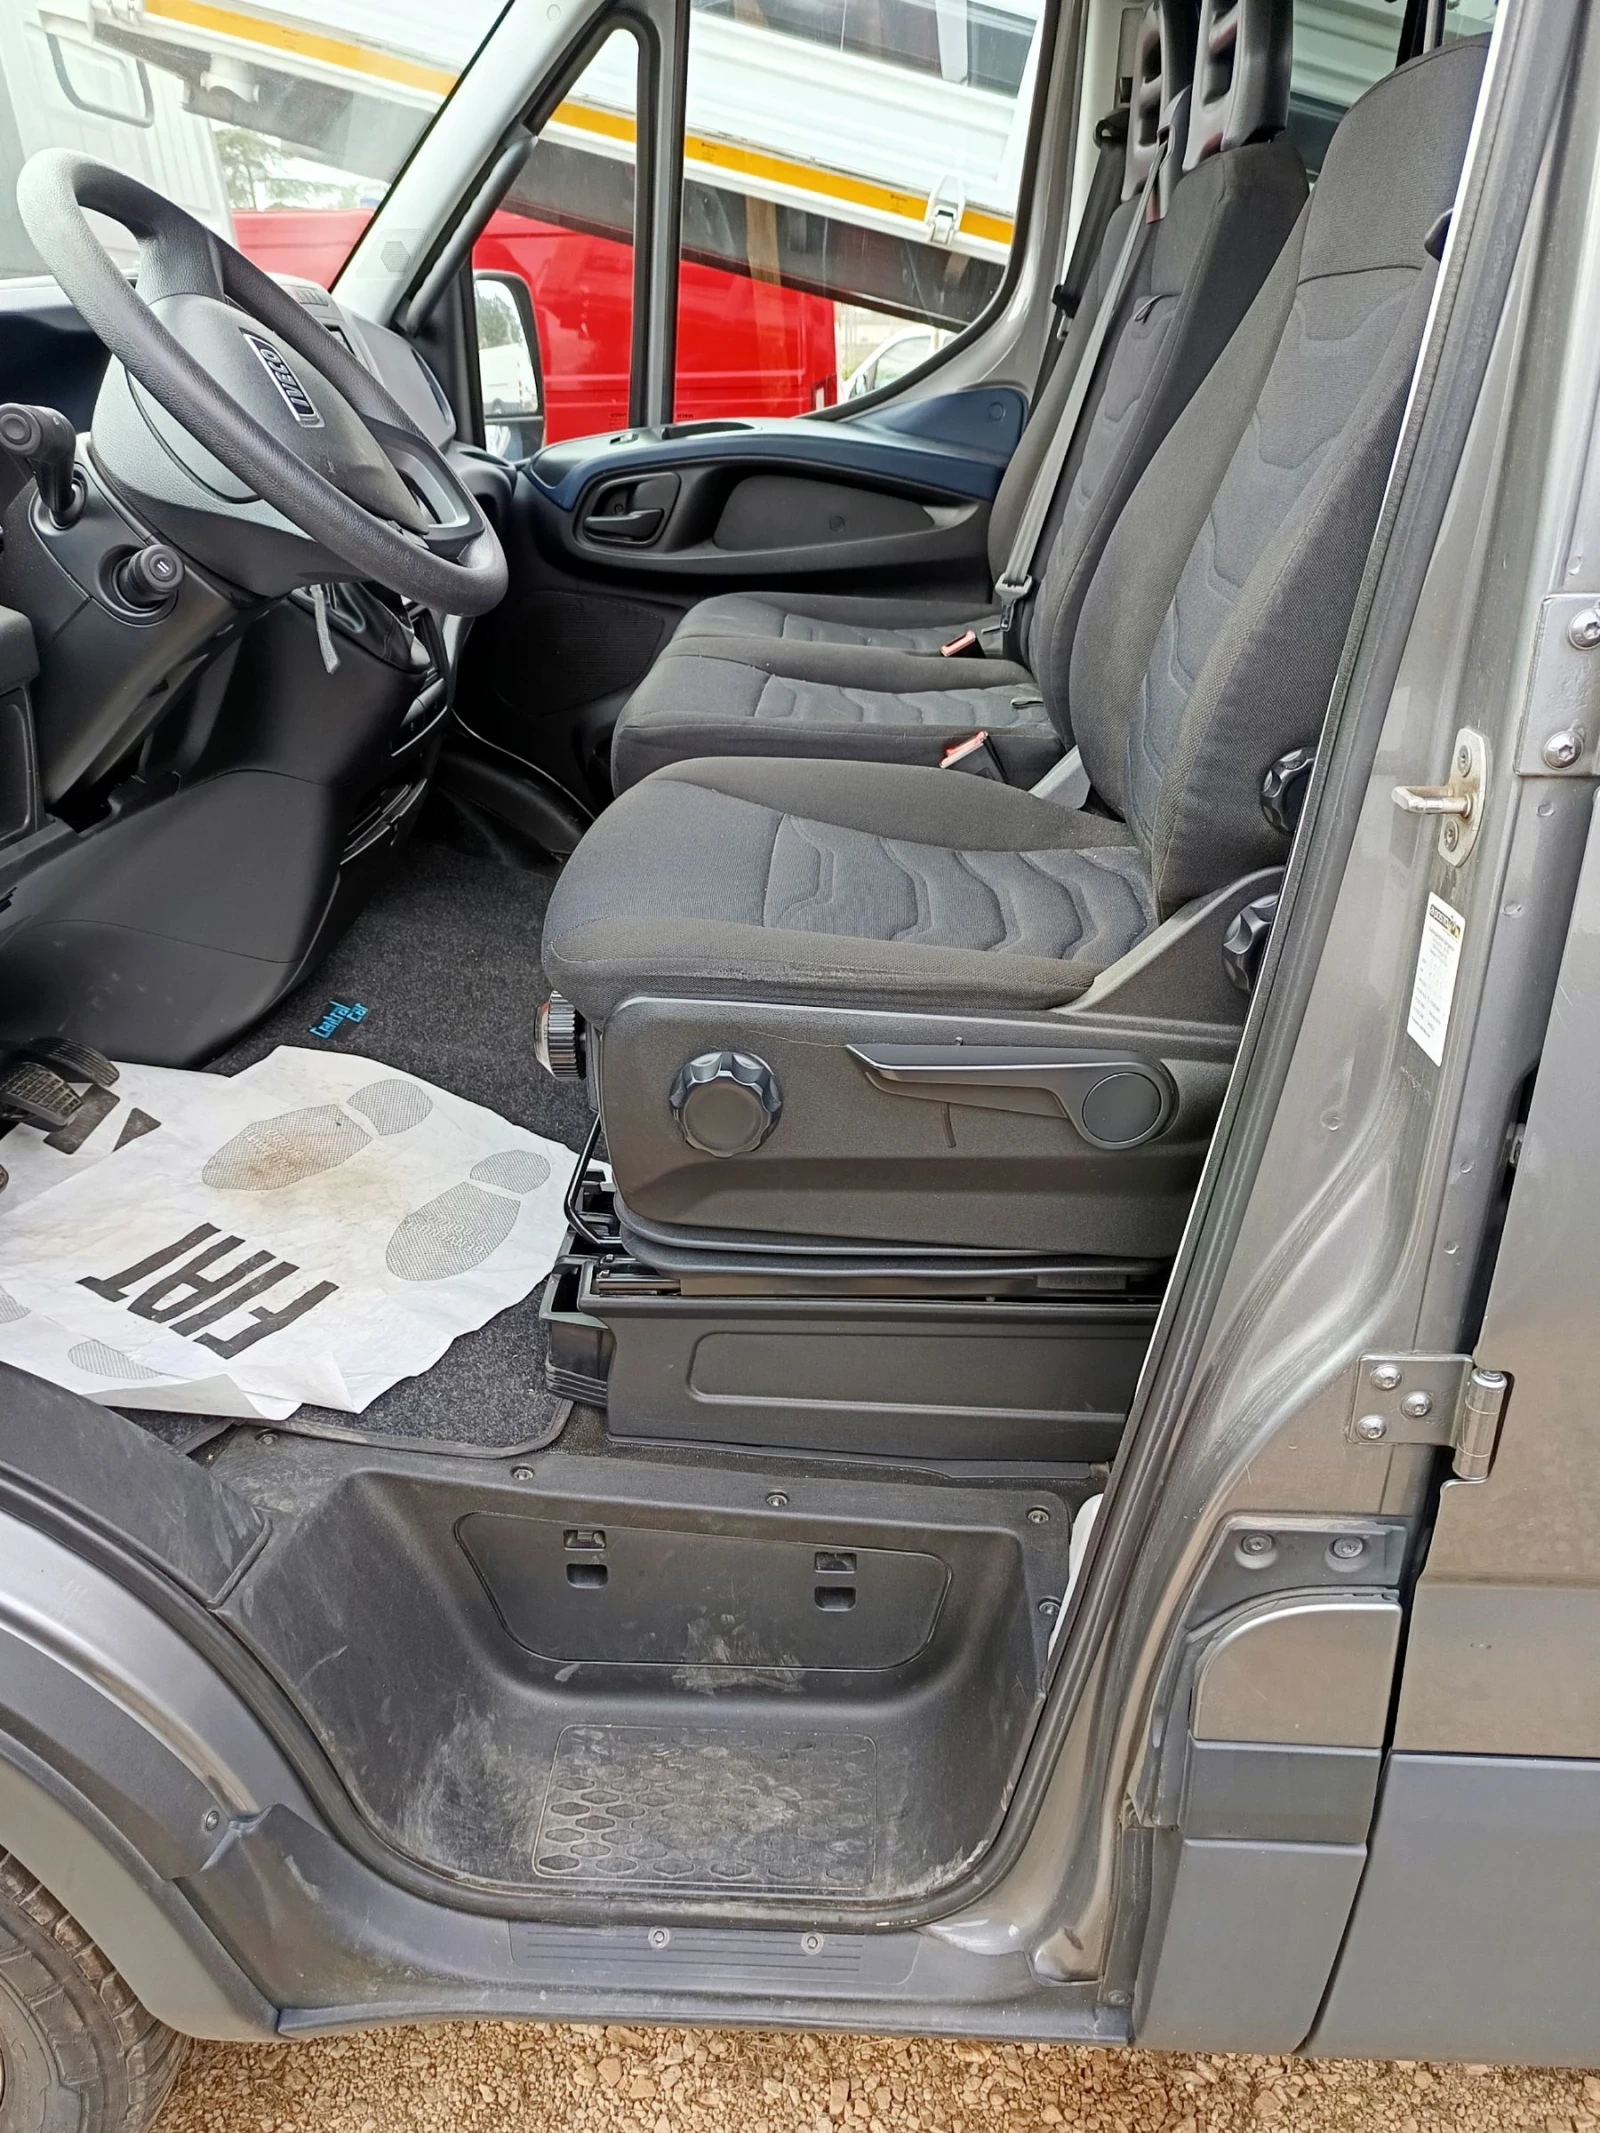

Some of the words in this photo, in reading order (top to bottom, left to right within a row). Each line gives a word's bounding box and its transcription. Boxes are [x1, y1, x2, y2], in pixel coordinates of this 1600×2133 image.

[260, 348, 310, 408] IVECO
[405, 1220, 485, 1256] BENVENUTI
[75, 1222, 340, 1360] FIAT
